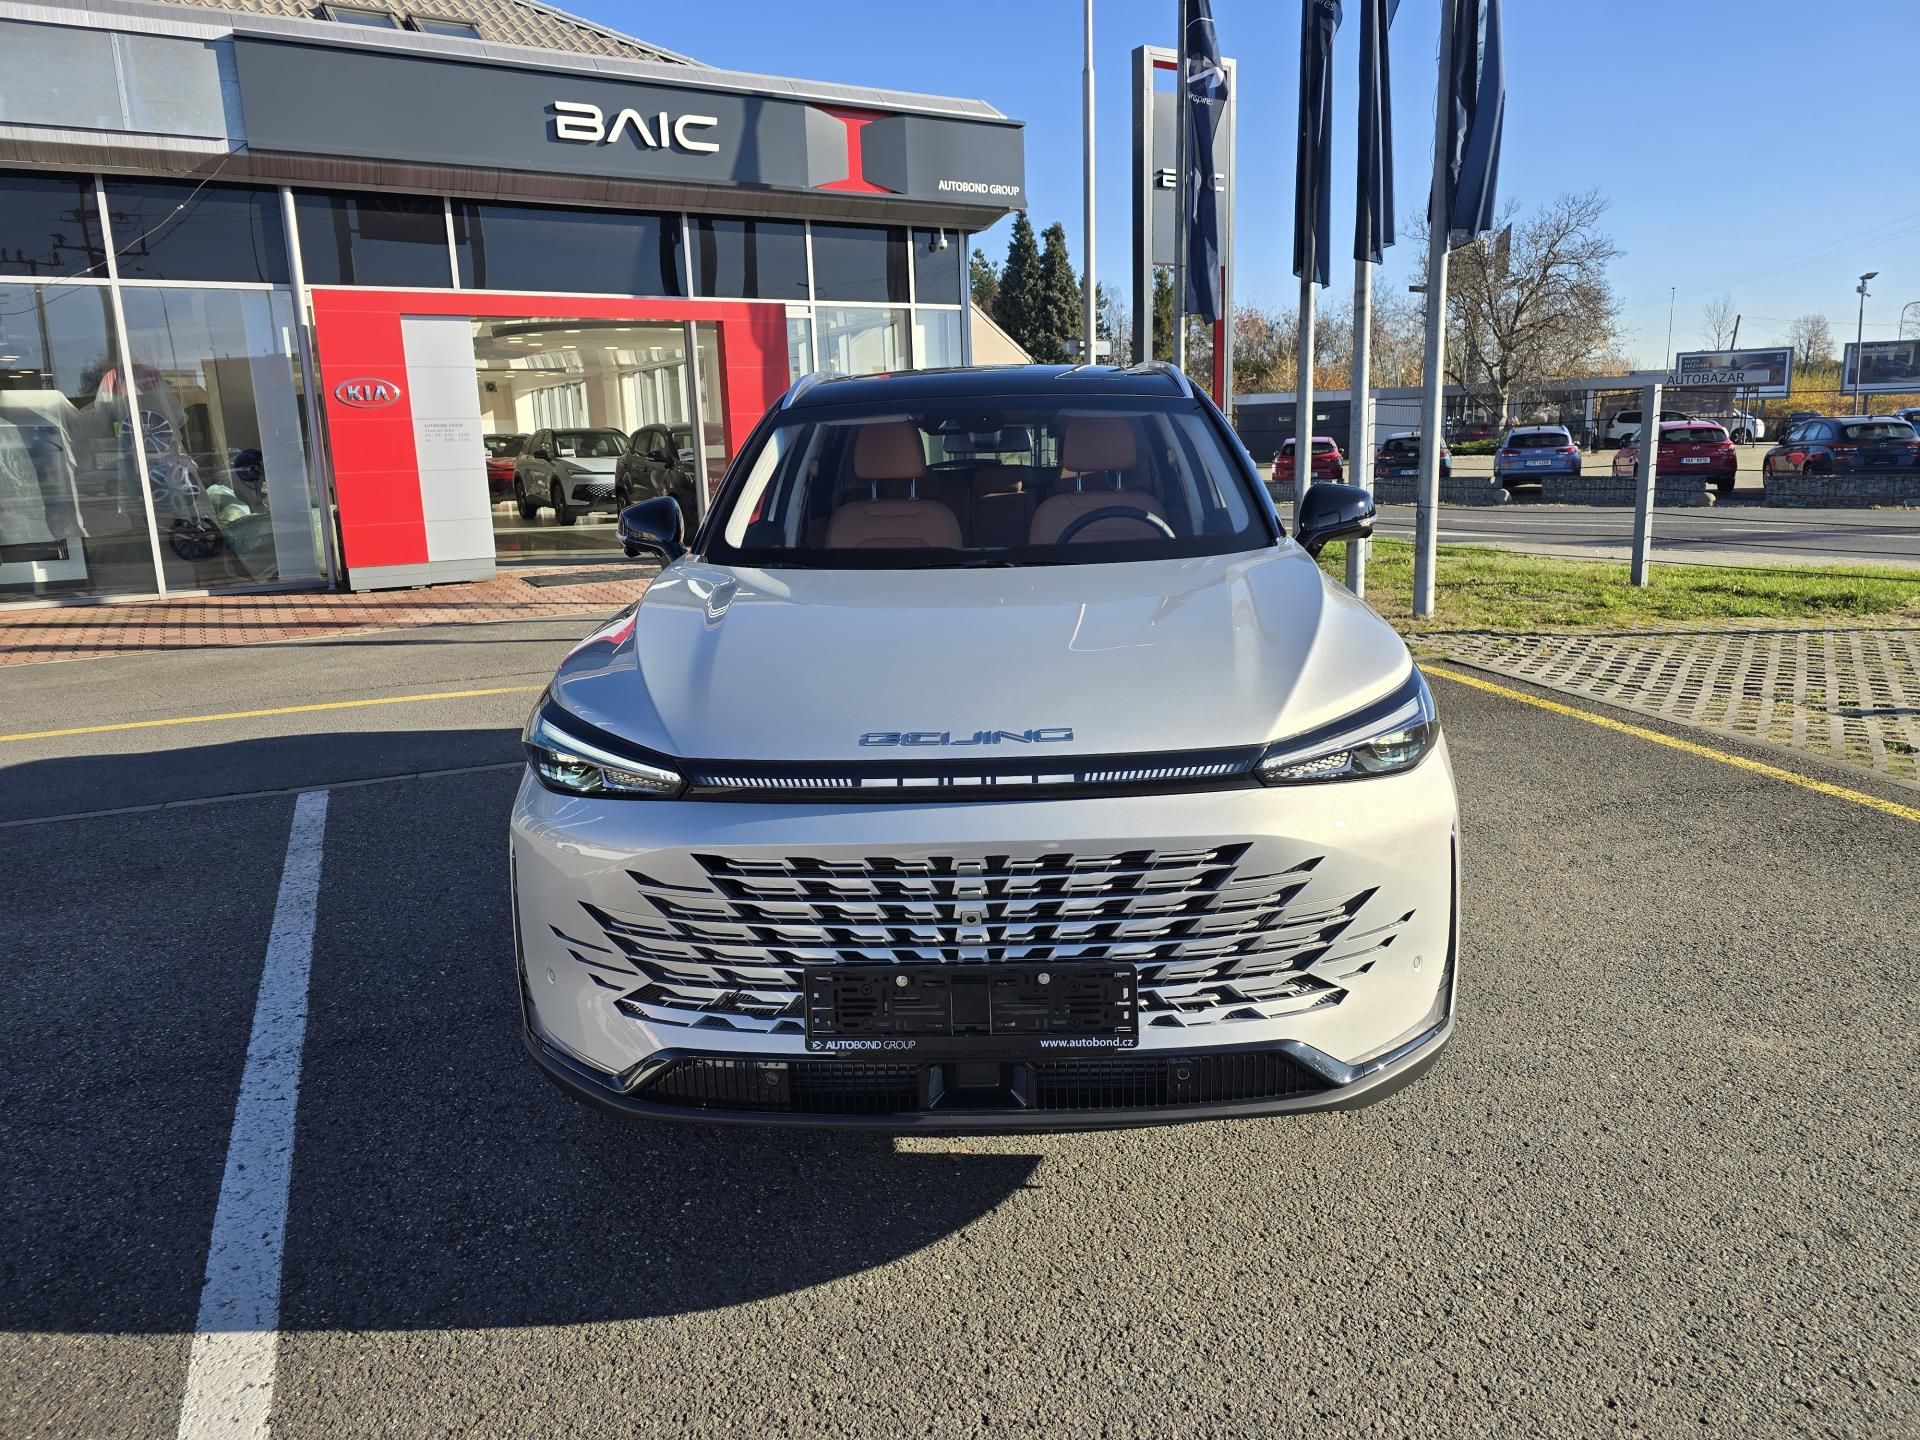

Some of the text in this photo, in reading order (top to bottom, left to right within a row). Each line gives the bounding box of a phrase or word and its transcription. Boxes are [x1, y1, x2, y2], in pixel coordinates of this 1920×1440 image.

[554, 100, 720, 152] BAIC
[938, 179, 1020, 196] AUTOBOND GROUP
[1666, 372, 1745, 385] AUTOBAZAR
[346, 385, 390, 401] KIA
[858, 727, 1074, 747] BEIJING
[825, 1040, 916, 1050] AUTOBOND GROUP
[1040, 1036, 1134, 1048] www.autobond.cz
